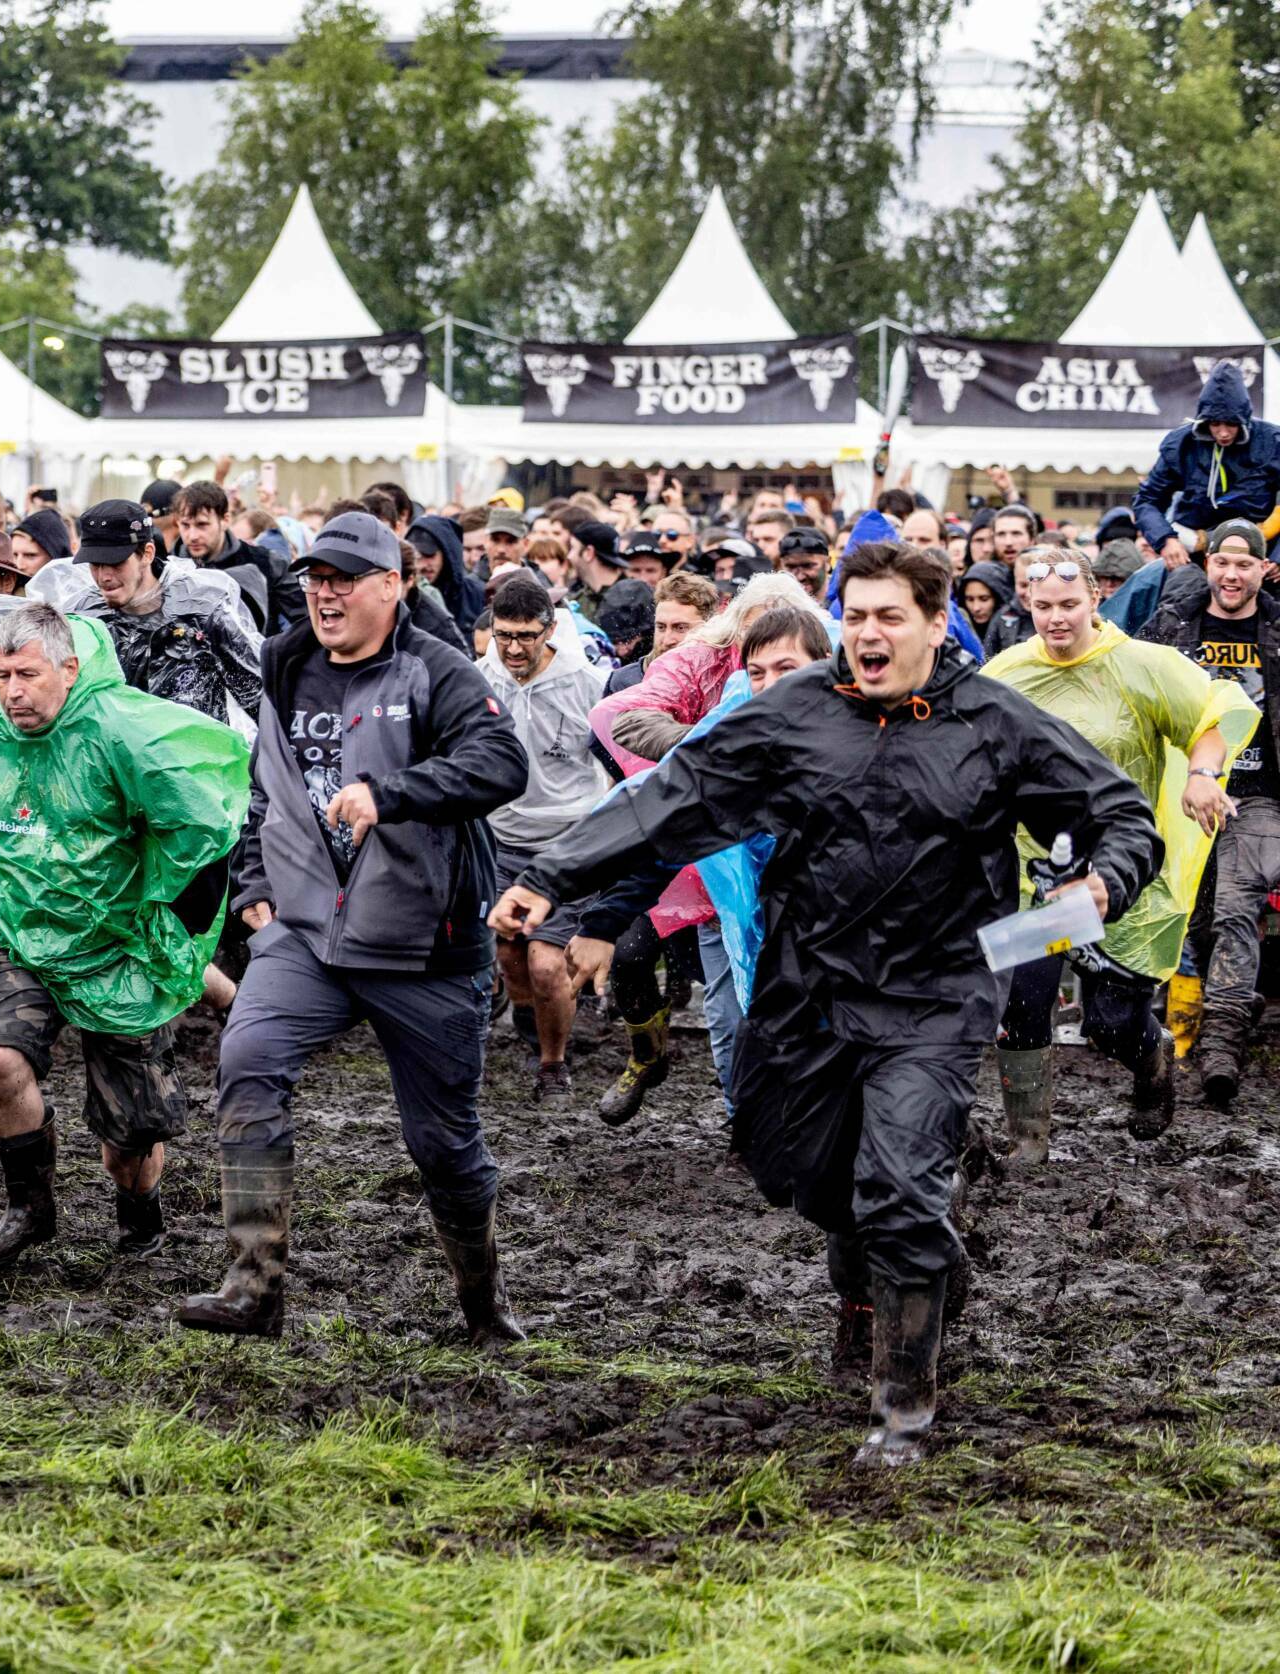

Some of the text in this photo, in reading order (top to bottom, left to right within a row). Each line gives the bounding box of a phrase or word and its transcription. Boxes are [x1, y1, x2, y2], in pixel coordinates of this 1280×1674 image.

[179, 346, 350, 384] SLUSH
[611, 353, 768, 388] FINGER
[1035, 356, 1144, 387] ASIA
[224, 381, 310, 414] ICE
[635, 384, 747, 416] FOOD
[1016, 382, 1161, 416] CHINA
